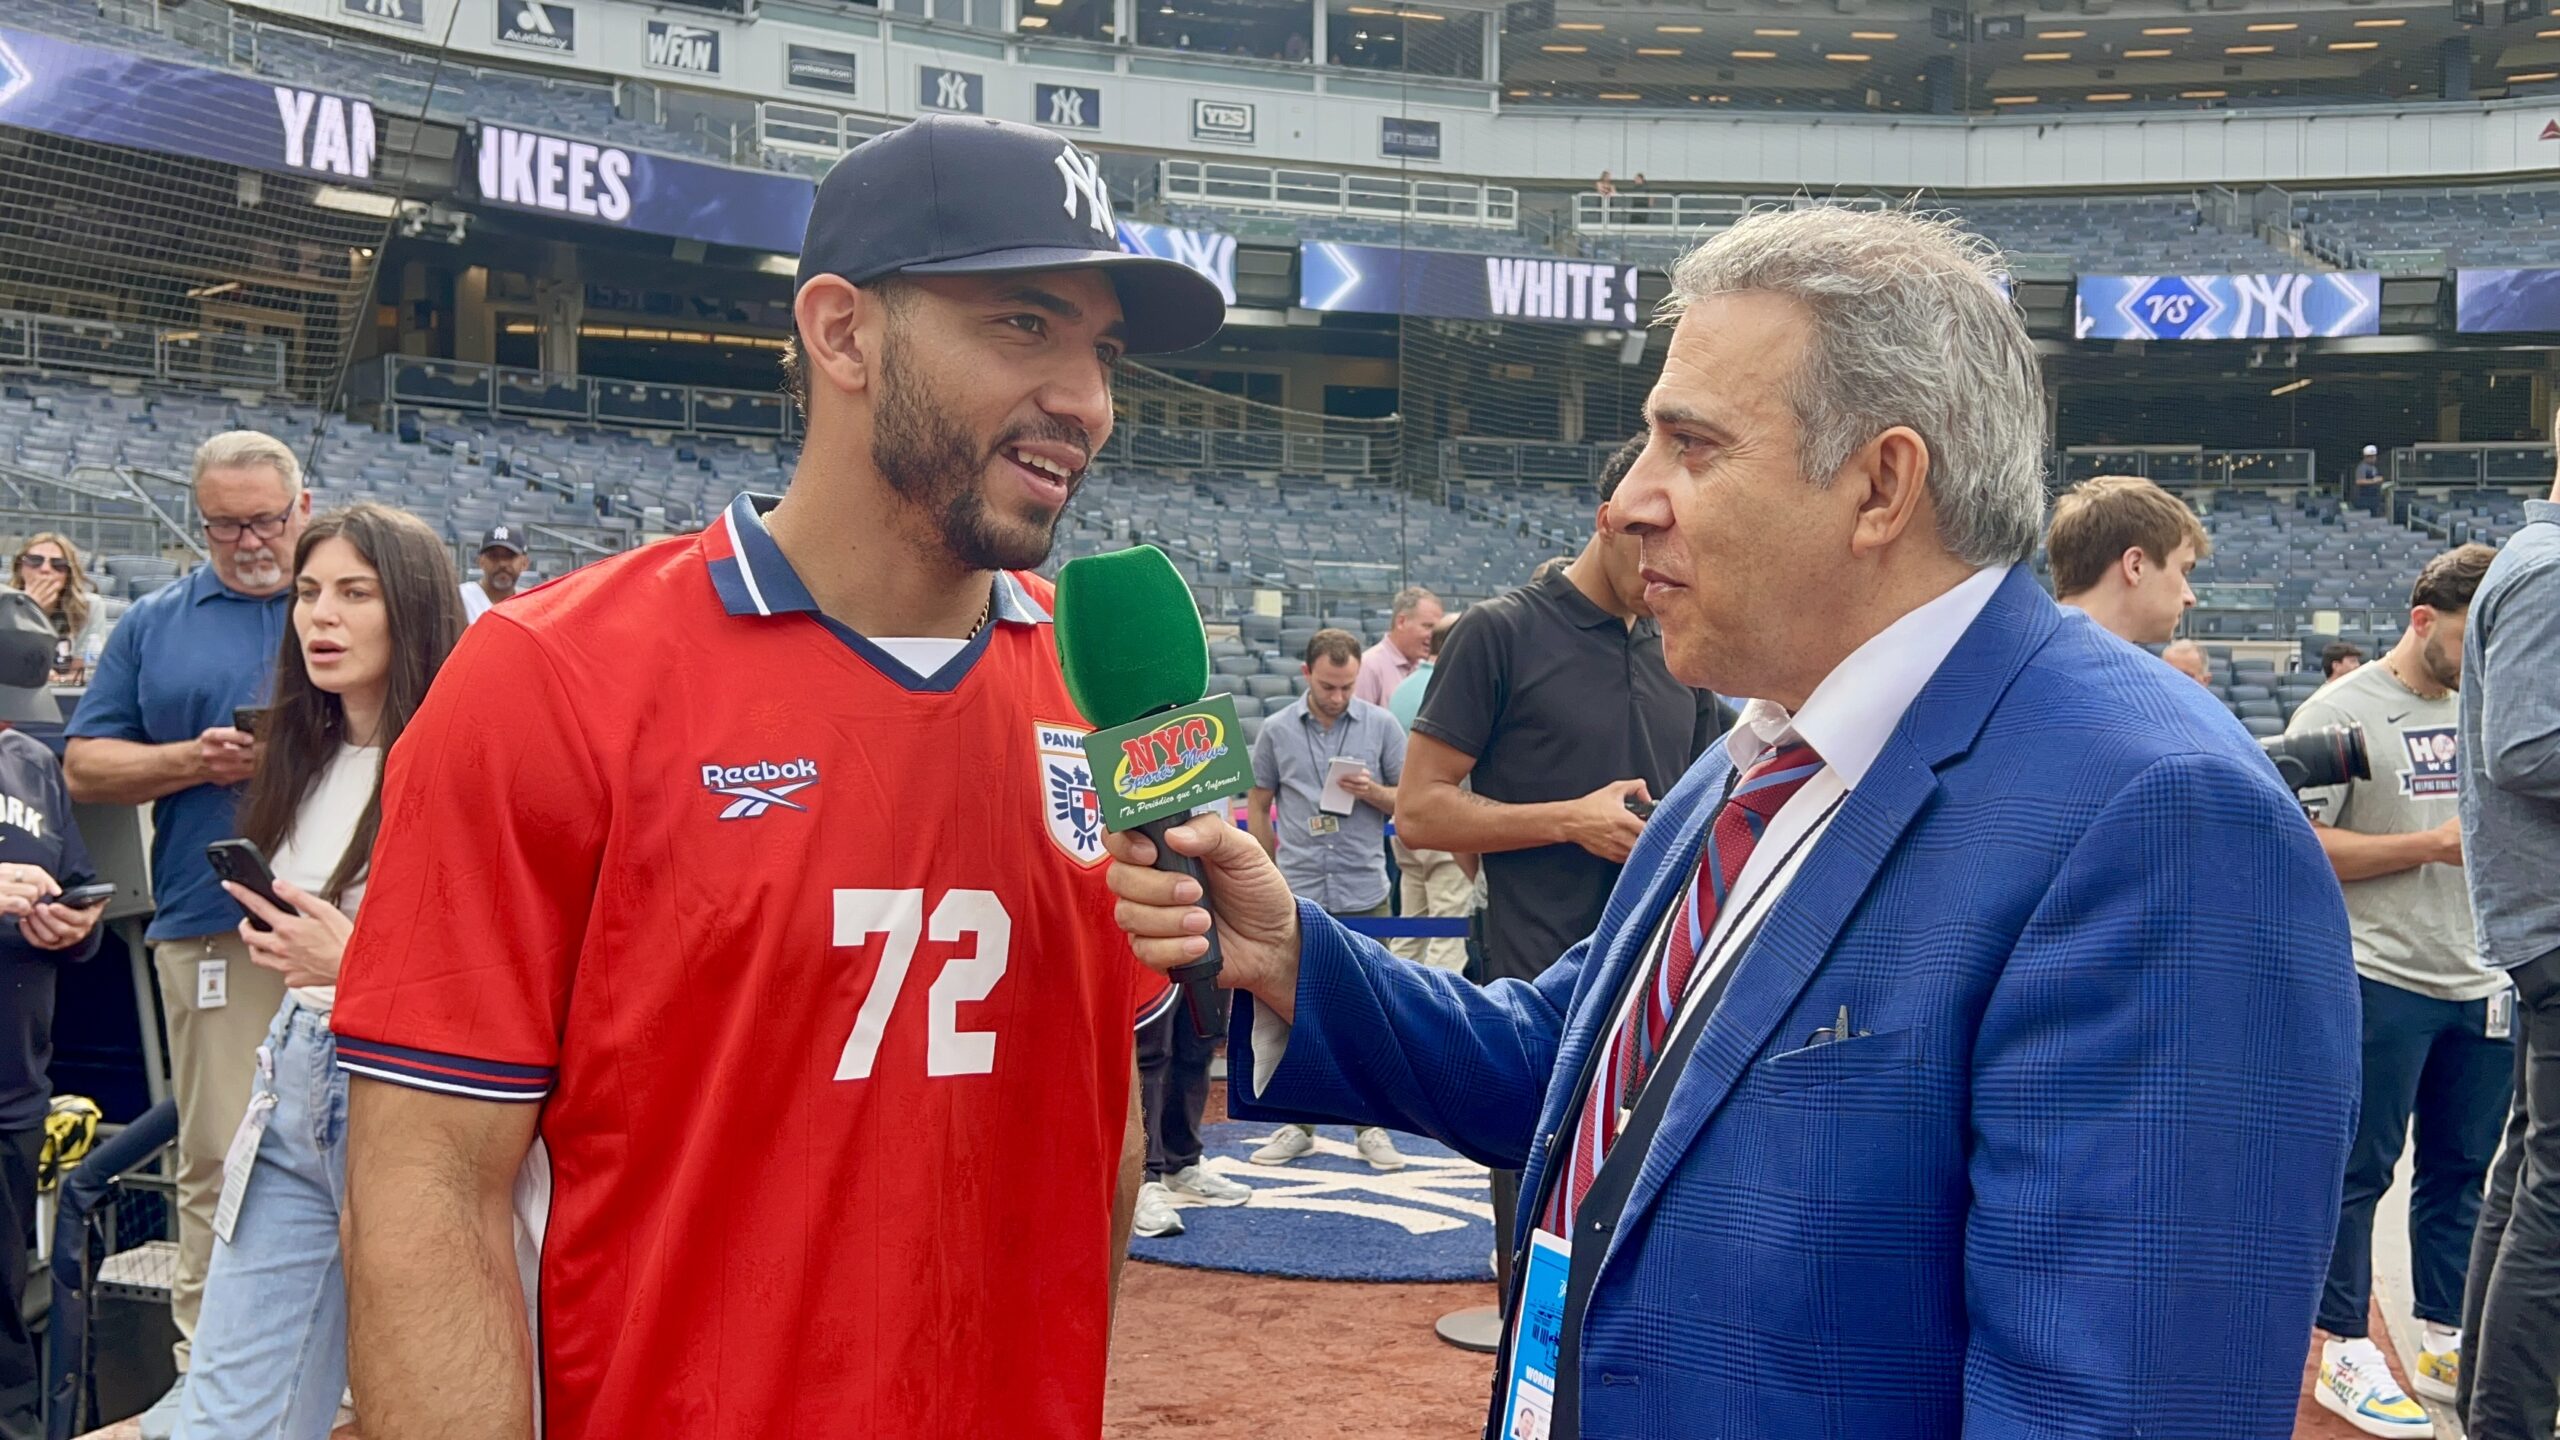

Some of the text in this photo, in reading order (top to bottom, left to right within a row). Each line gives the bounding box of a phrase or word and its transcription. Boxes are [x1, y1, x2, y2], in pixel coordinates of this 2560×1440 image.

[503, 28, 568, 50] Audacy
[649, 24, 713, 71] WFAN
[936, 72, 969, 111] NY
[1050, 88, 1084, 126] NY
[1203, 106, 1245, 127] YES
[1054, 145, 1116, 240] NY
[1486, 257, 1616, 322] WHITE
[2229, 273, 2313, 338] NY
[1118, 743, 1229, 797] Sports News
[1121, 718, 1212, 779] NYC
[701, 758, 818, 789] Reebok
[1176, 790, 1191, 802] que
[1191, 783, 1204, 795] Te
[1204, 770, 1241, 791] Informa!
[832, 887, 1012, 1081] 72
